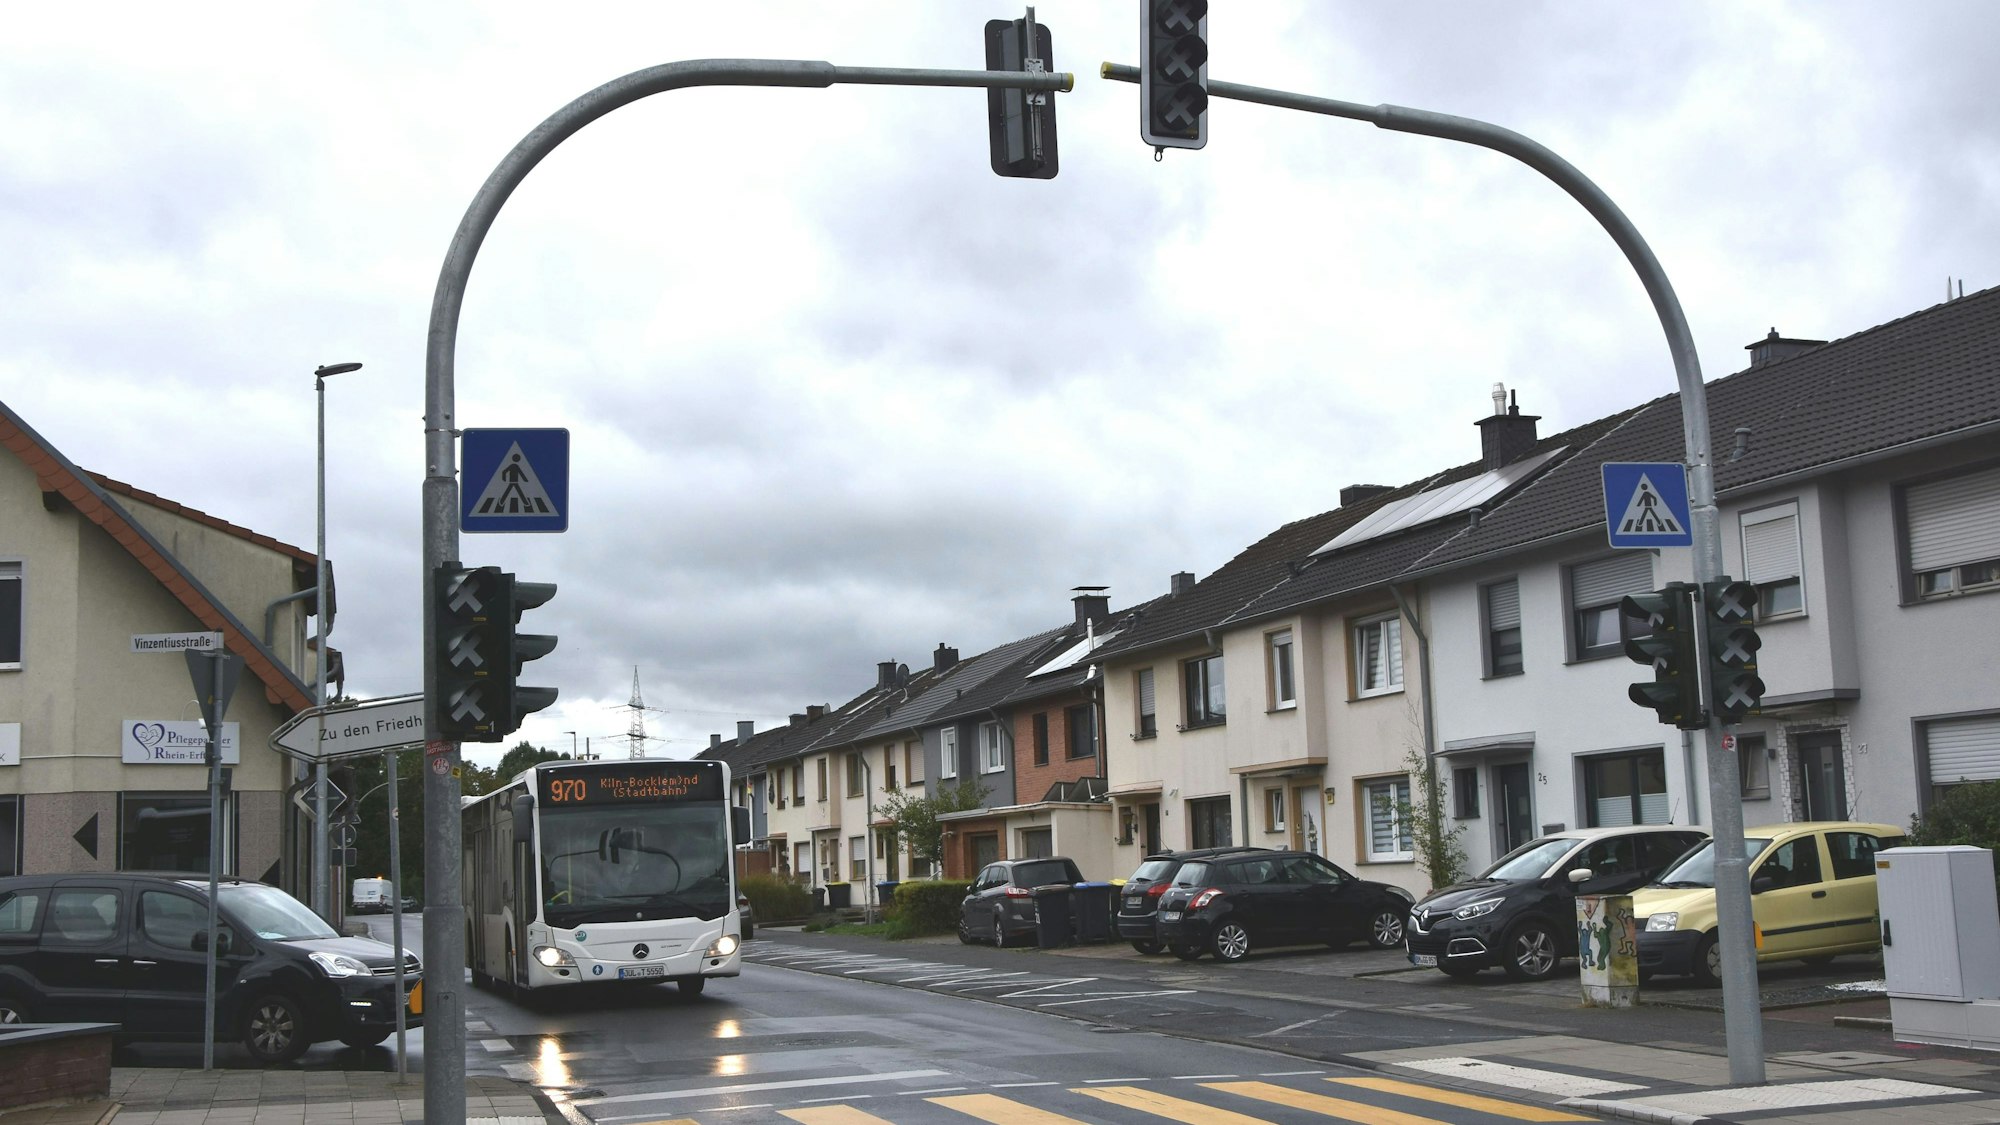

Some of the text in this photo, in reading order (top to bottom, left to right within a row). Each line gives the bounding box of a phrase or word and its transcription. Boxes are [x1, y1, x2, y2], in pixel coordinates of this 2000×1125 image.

[319, 728, 337, 741] Zu
[344, 725, 370, 738] den
[489, 720, 495, 733] 1
[167, 731, 231, 745] Pflegepaer
[1537, 772, 1548, 785] 25
[551, 778, 586, 802] 970
[613, 785, 687, 798] (Stadtbahn)
